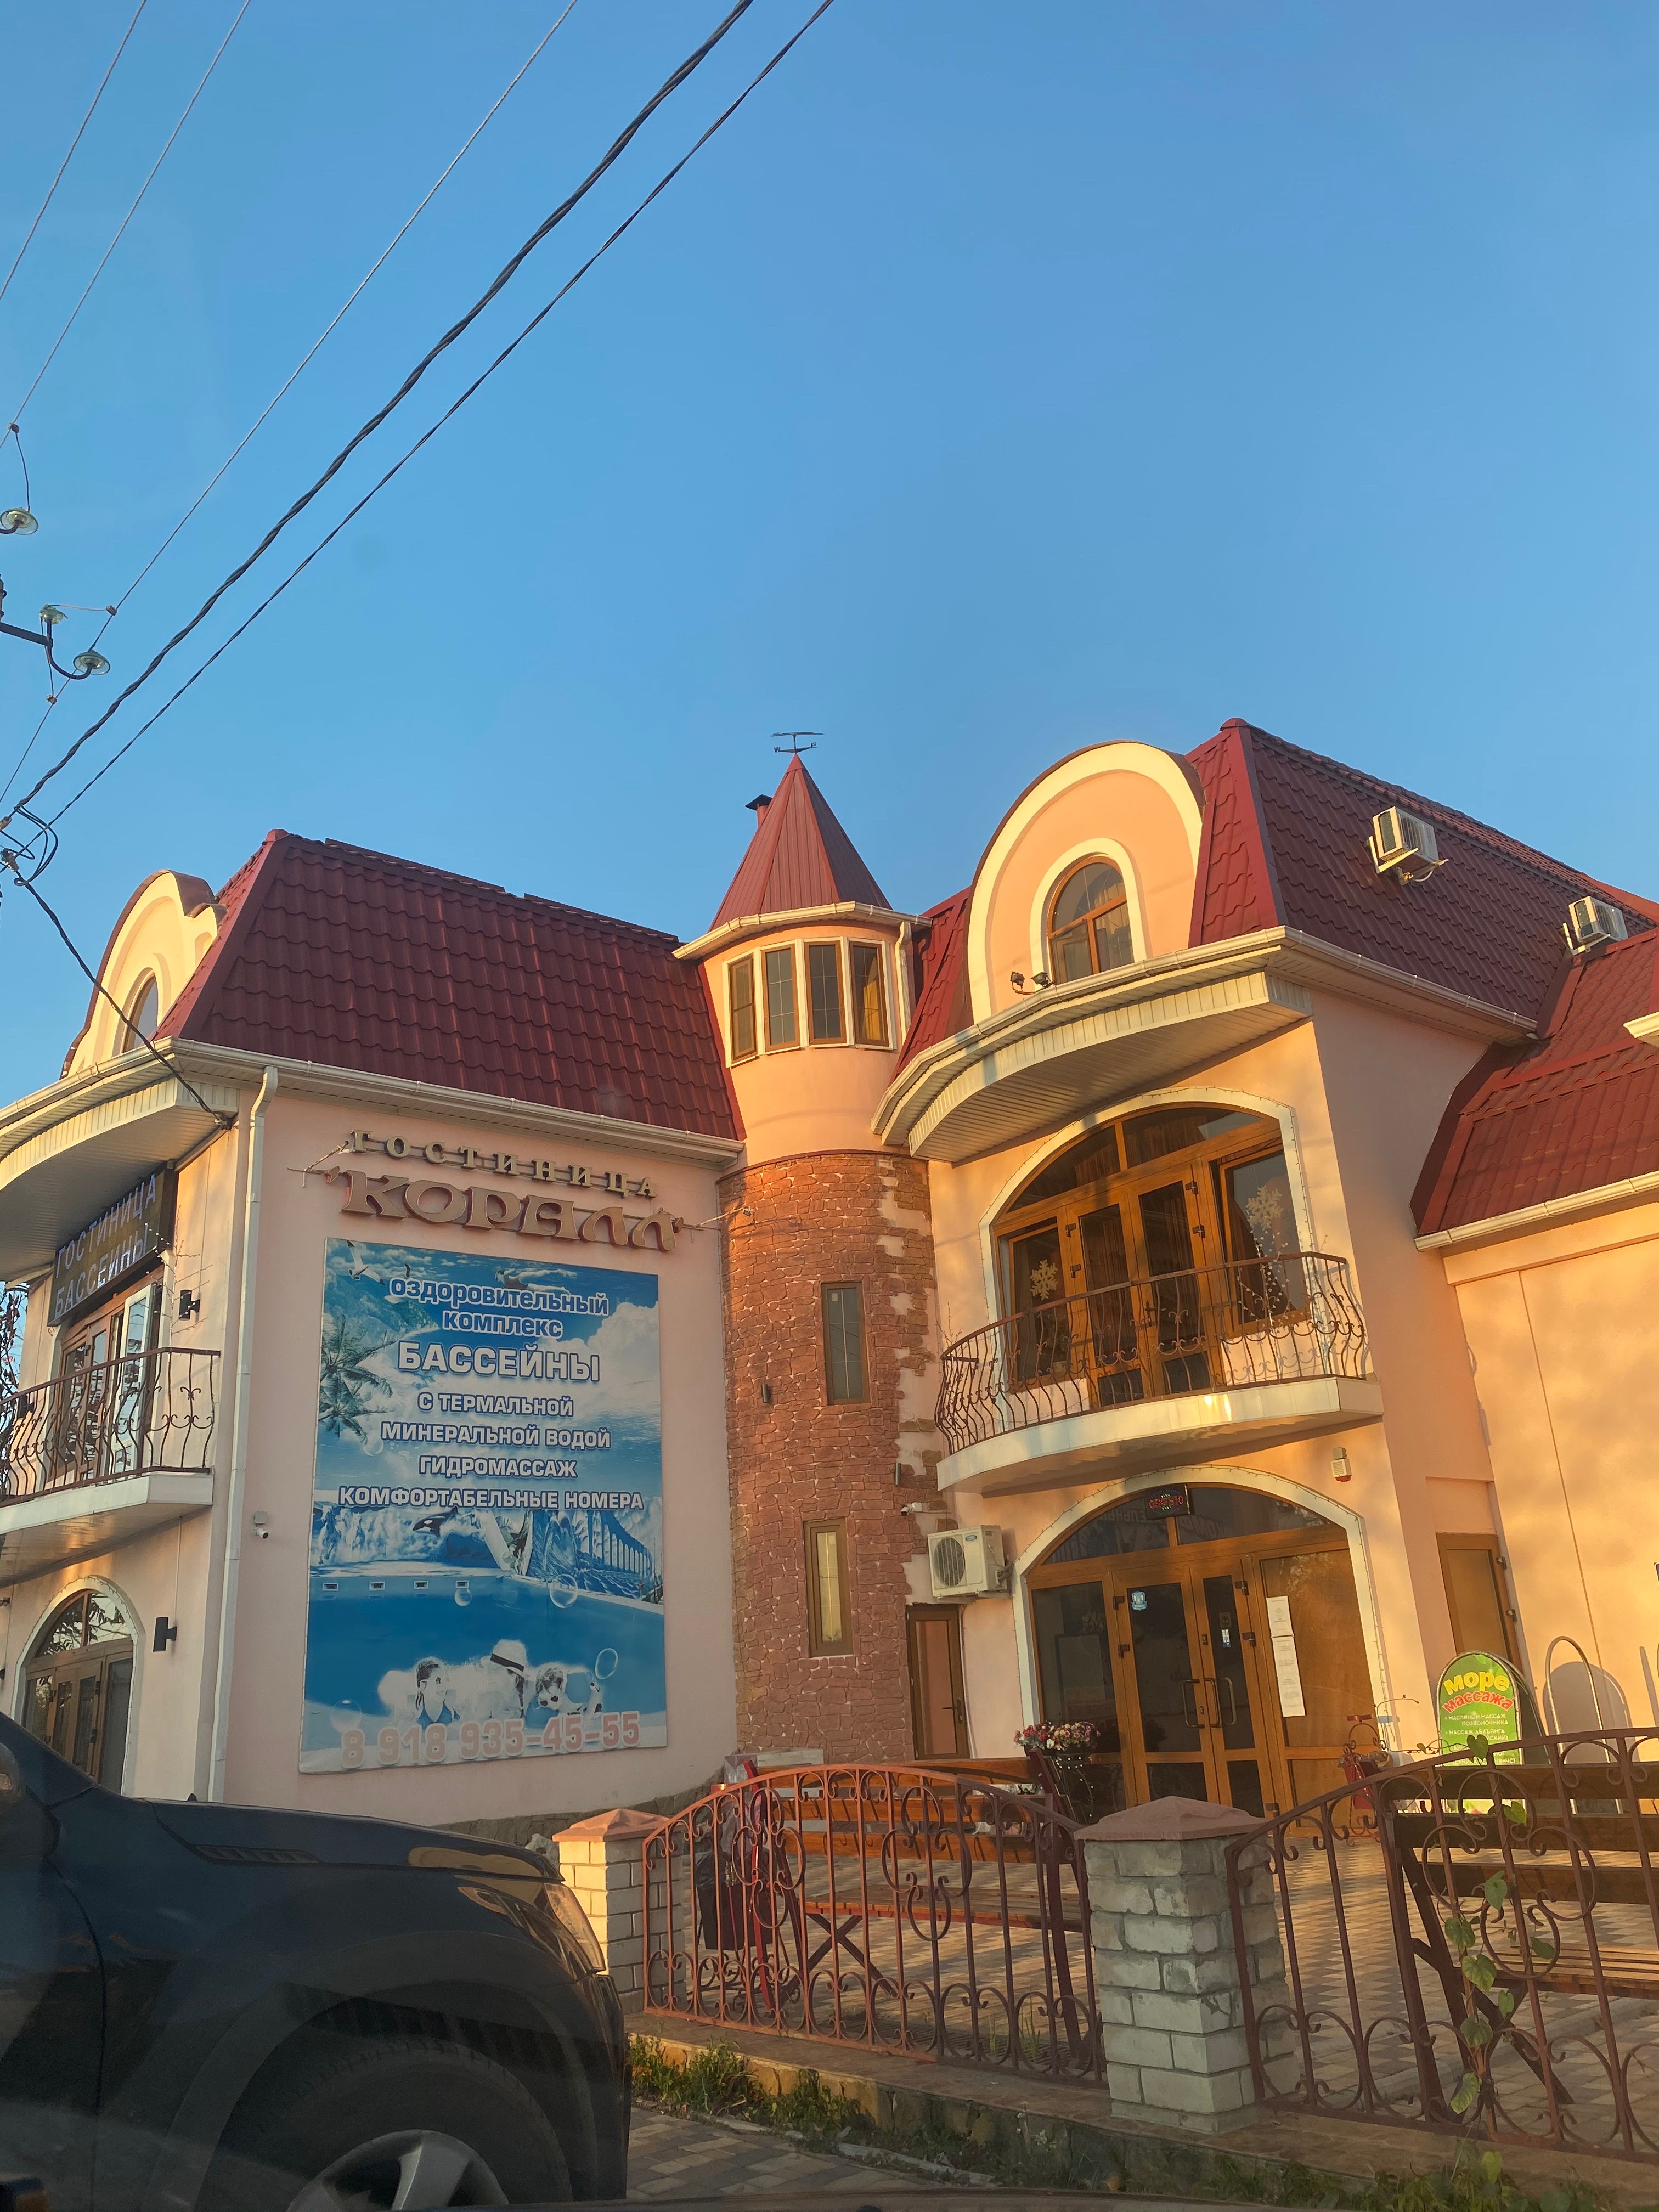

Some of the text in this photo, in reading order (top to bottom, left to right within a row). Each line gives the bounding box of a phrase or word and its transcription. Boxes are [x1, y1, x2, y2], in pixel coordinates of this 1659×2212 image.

[350, 1129, 657, 1198] ГОСТИНИЦА
[55, 1173, 156, 1279] ГОСТИНИЦА
[390, 1278, 608, 1316] оздоровительный
[443, 1310, 563, 1339] комплекс
[398, 1340, 600, 1382] БАССЕЙНЫ
[418, 1392, 574, 1417] С ТЕРМАЛЬНОЙ
[381, 1421, 611, 1450] МИНЕРАЛЬНОЙ ВОДОЙ
[420, 1455, 578, 1478] ГИДРОМАССАЖ
[338, 1486, 645, 1510] КОМФОРТАБЕЛЬНЫЕ НОМЕРА
[1443, 1672, 1510, 1695] море
[1442, 1691, 1514, 1713] массажа
[1448, 1712, 1480, 1720] МАСЛЯНЫЙ
[342, 1711, 640, 1769] 8 918 935-45-55
